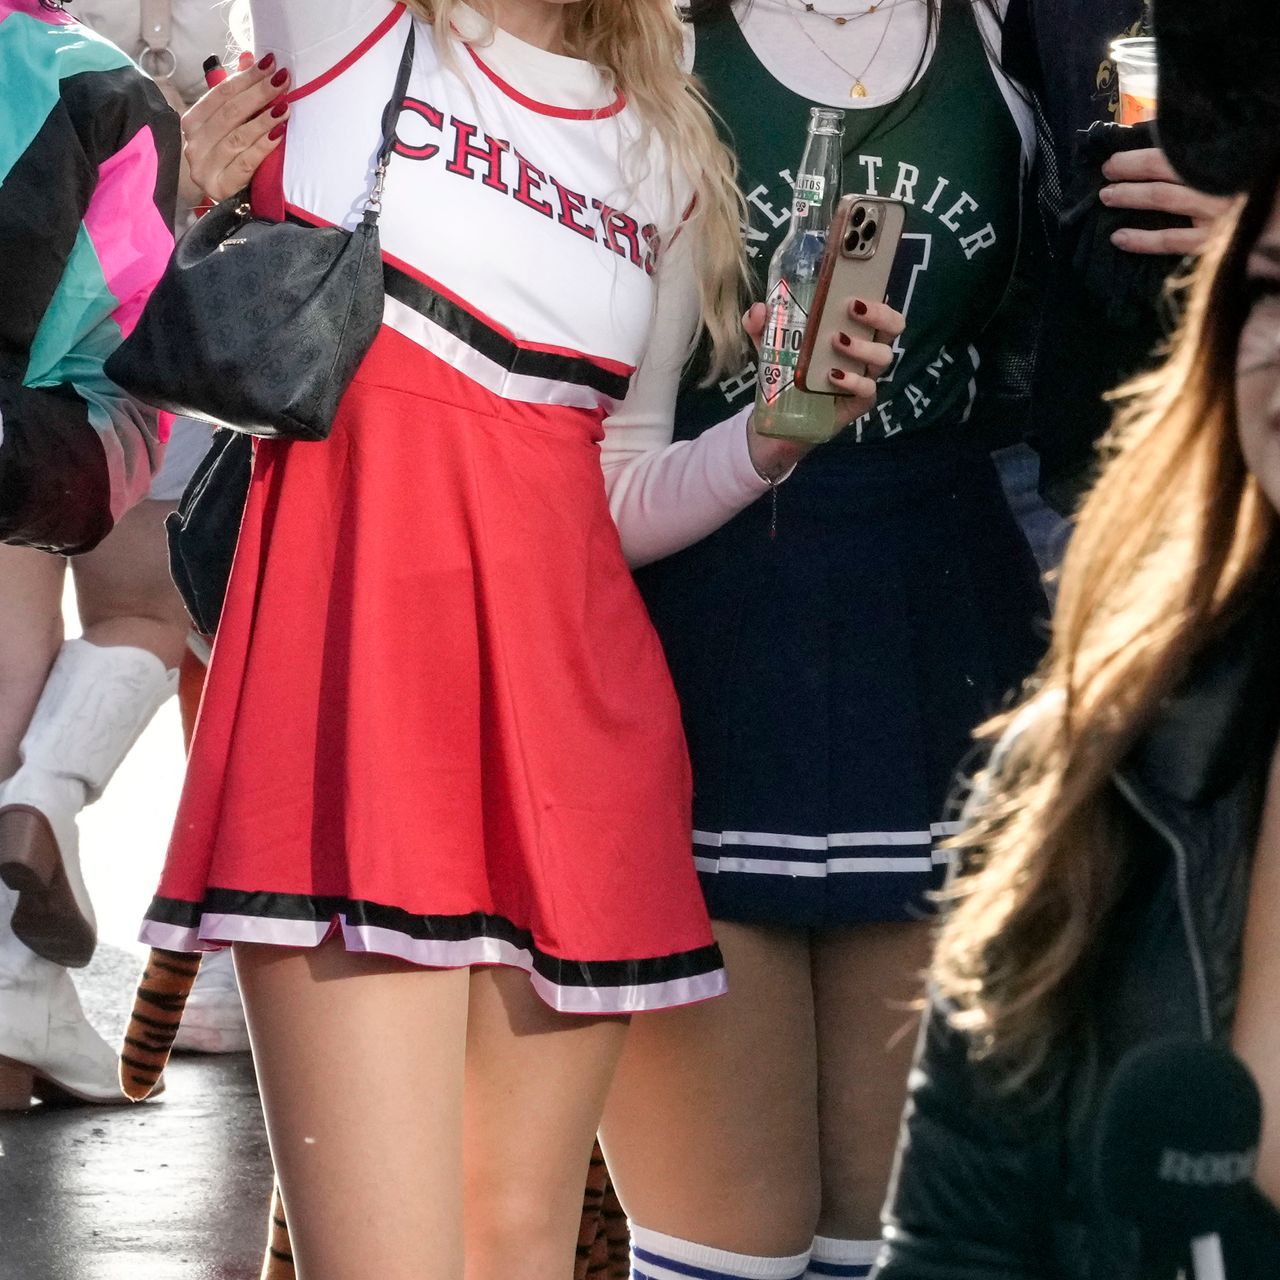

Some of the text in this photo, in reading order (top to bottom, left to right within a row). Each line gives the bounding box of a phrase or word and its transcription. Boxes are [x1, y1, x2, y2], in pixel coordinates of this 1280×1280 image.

[381, 96, 661, 276] CHEERS
[858, 154, 997, 260] TRIER
[765, 325, 803, 351] LITO
[849, 345, 955, 443] TEAM
